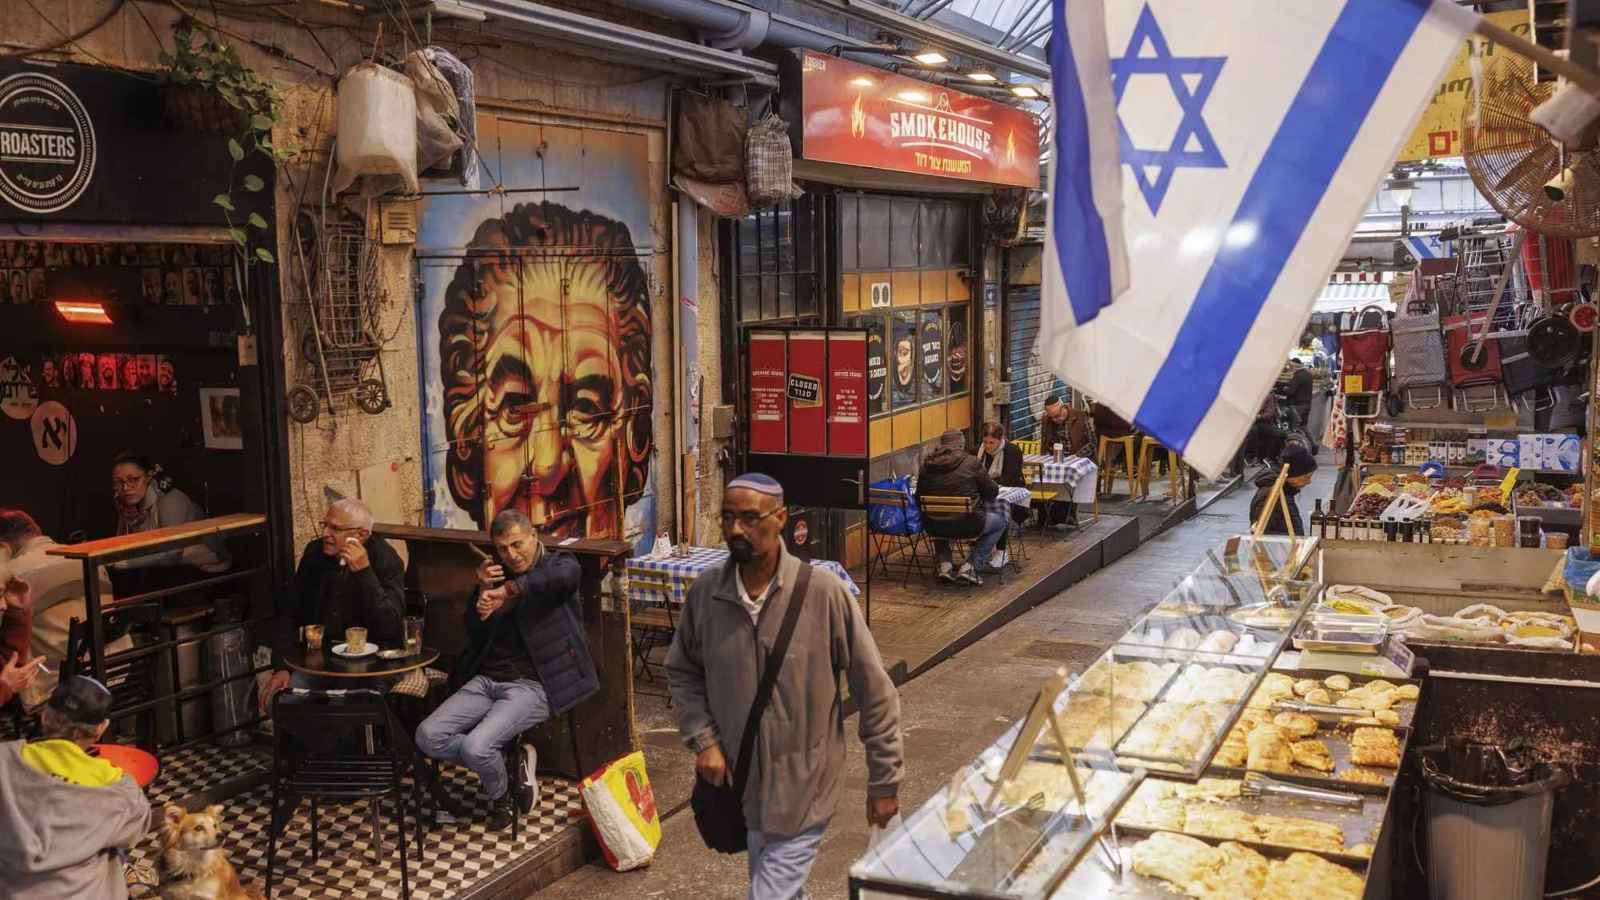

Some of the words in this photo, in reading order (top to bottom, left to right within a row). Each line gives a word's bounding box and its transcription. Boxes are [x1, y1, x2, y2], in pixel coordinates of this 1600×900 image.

[889, 112, 992, 153] SMOKEHOUSE
[0, 131, 76, 158] ROASTERS
[790, 379, 818, 391] CLOSED
[794, 388, 812, 398] סגור
